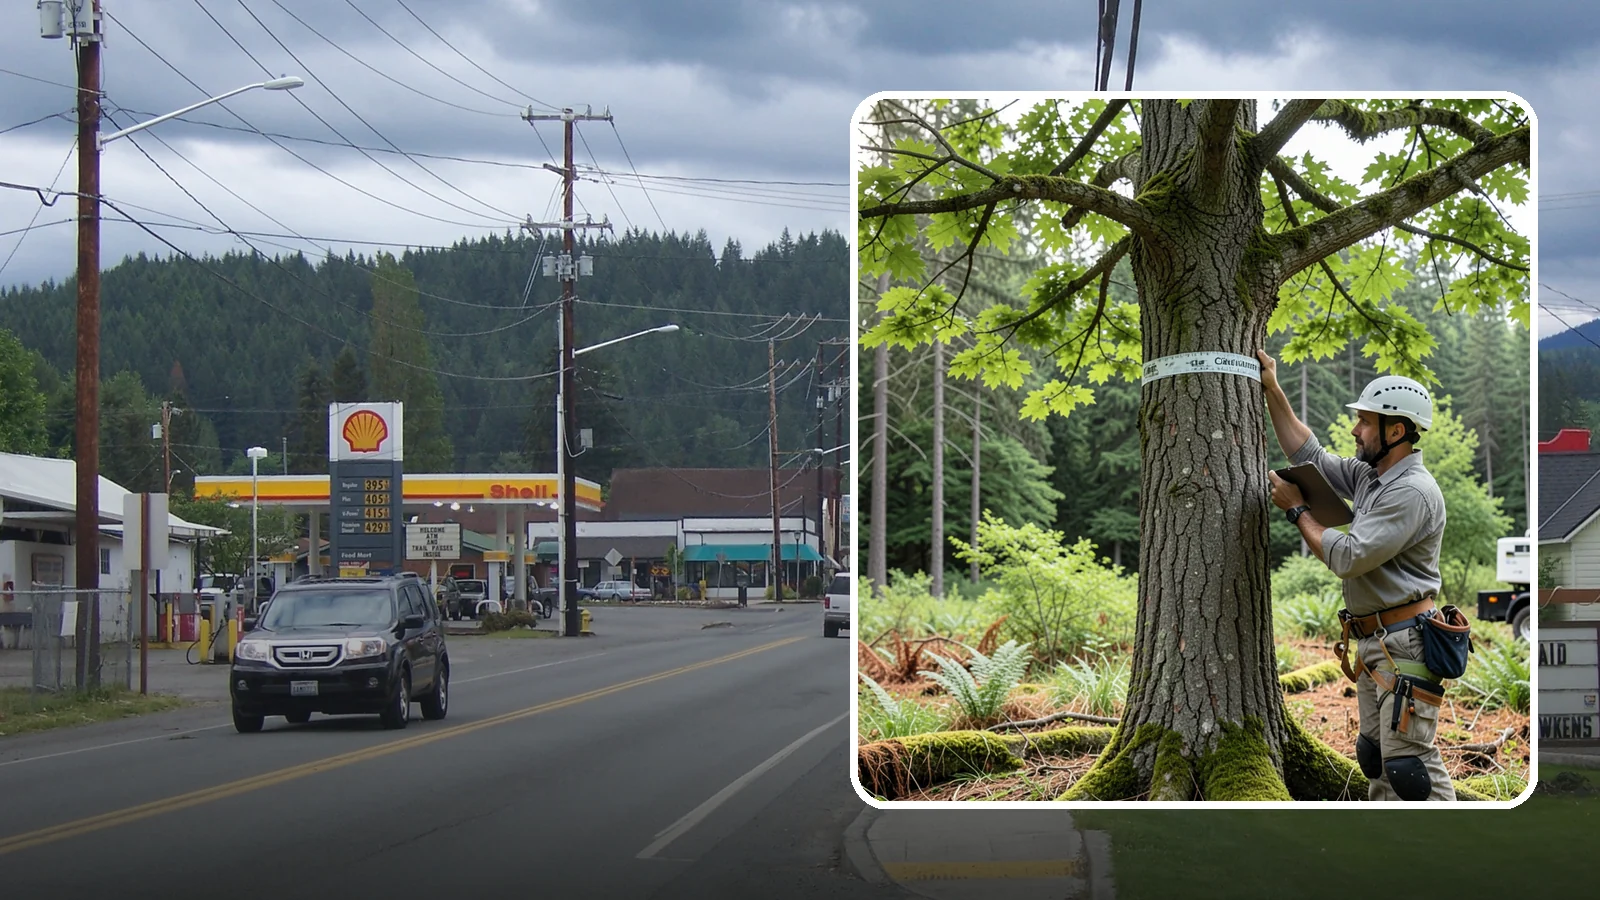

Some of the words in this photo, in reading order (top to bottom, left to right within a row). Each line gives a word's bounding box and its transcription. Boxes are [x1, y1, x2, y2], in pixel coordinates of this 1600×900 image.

[366, 480, 383, 490] 395
[490, 484, 547, 498] Shell
[366, 494, 383, 504] 405
[366, 508, 383, 518] 415
[366, 522, 383, 532] 429
